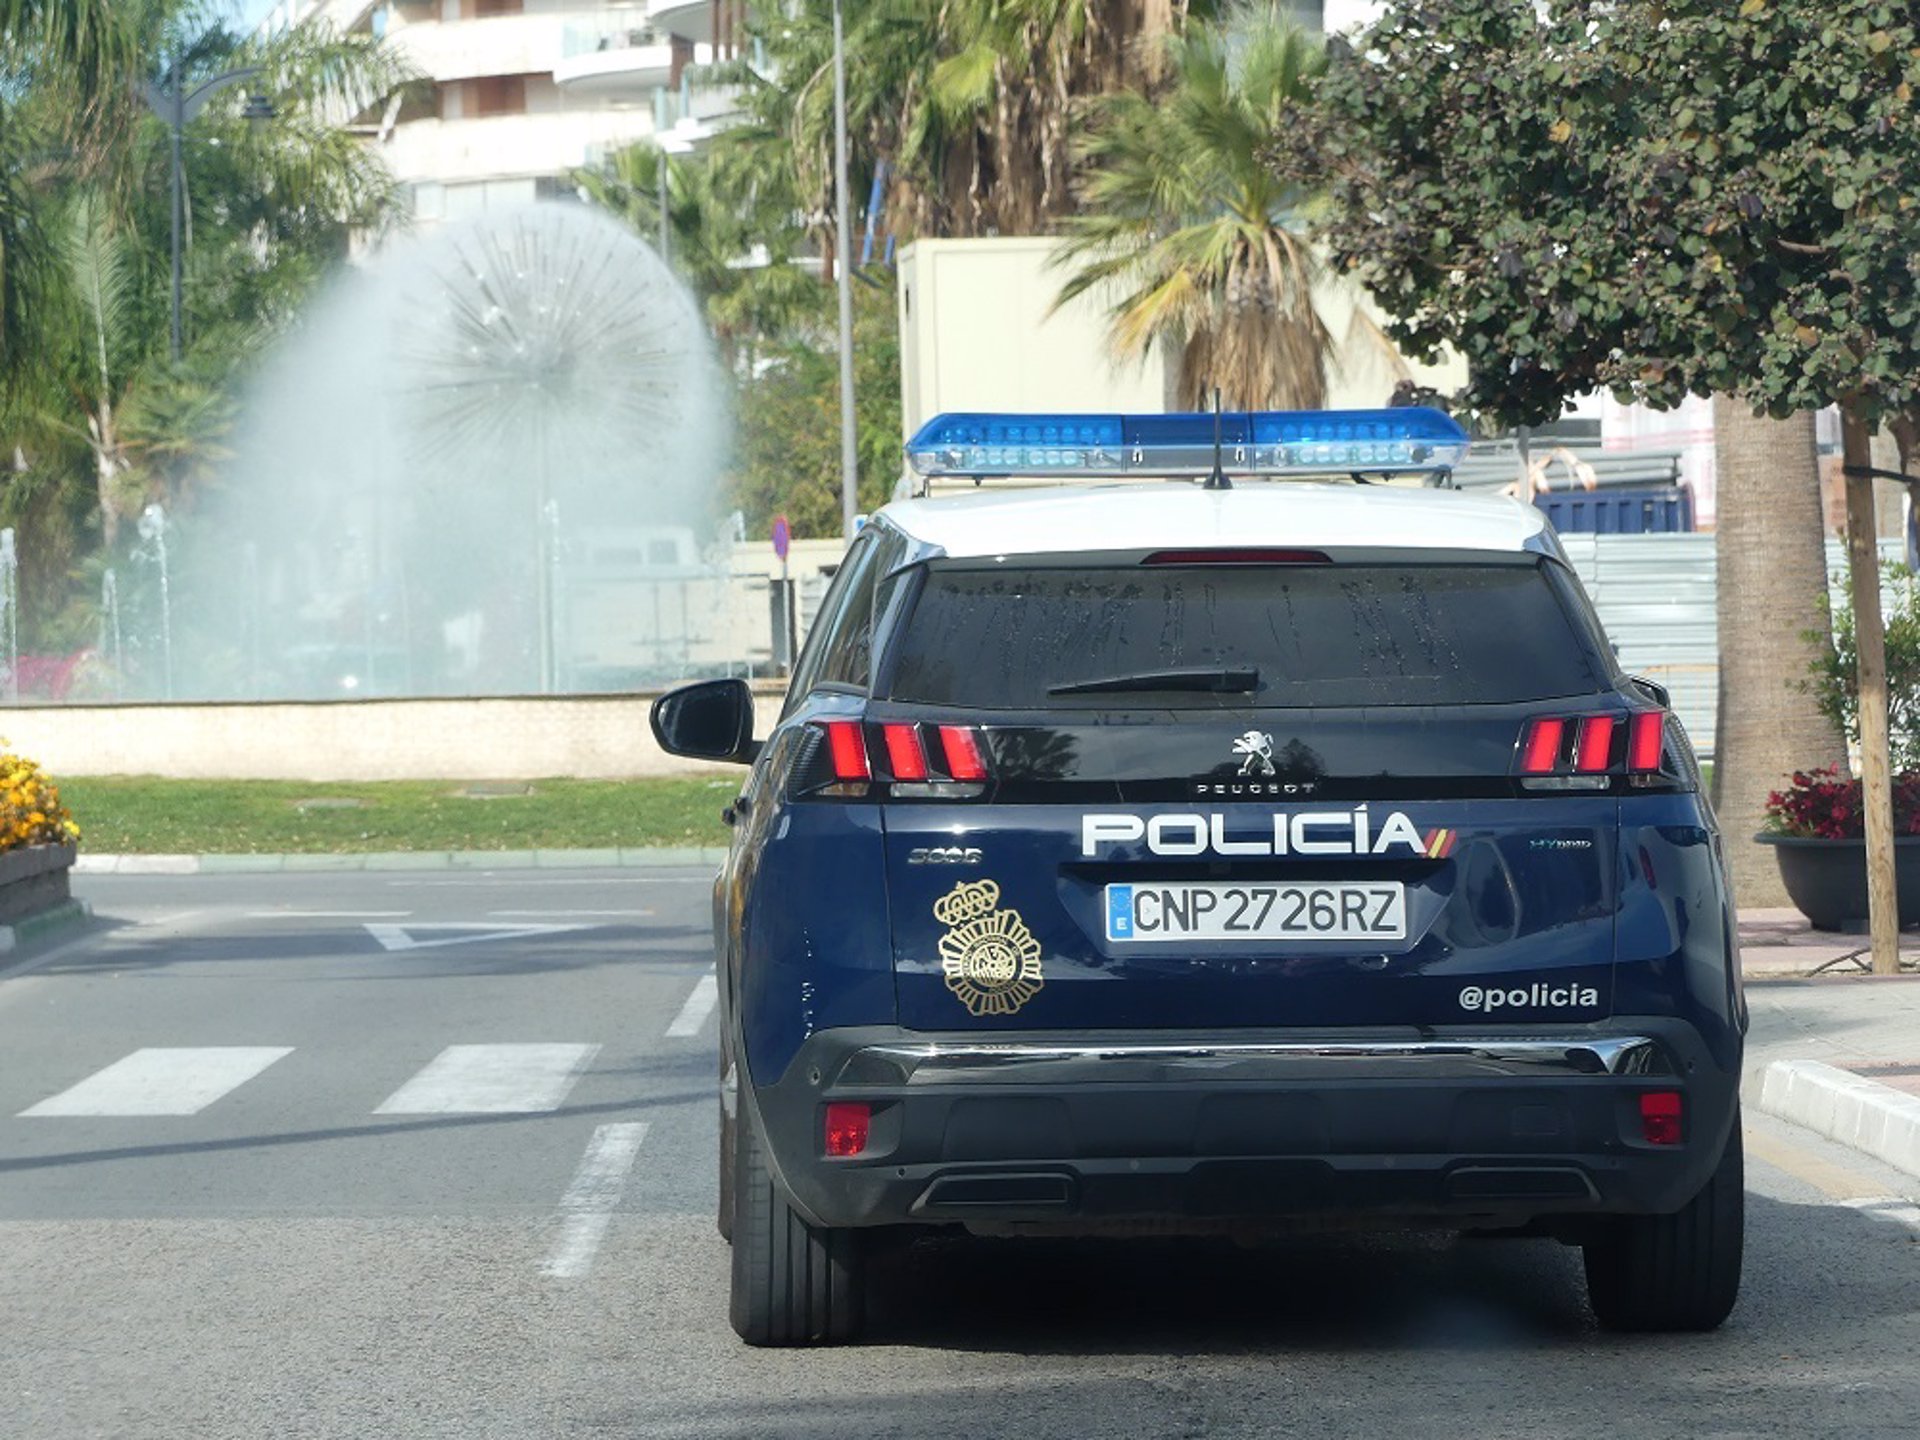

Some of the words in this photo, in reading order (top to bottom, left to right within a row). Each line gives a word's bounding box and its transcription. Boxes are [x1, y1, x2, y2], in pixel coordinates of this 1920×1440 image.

[1197, 783, 1315, 794] PEUGEOT
[1081, 804, 1427, 856] POLICÍA
[1115, 917, 1127, 930] E
[1134, 888, 1398, 932] CNP2726RZ
[1458, 983, 1599, 1013] @policia
